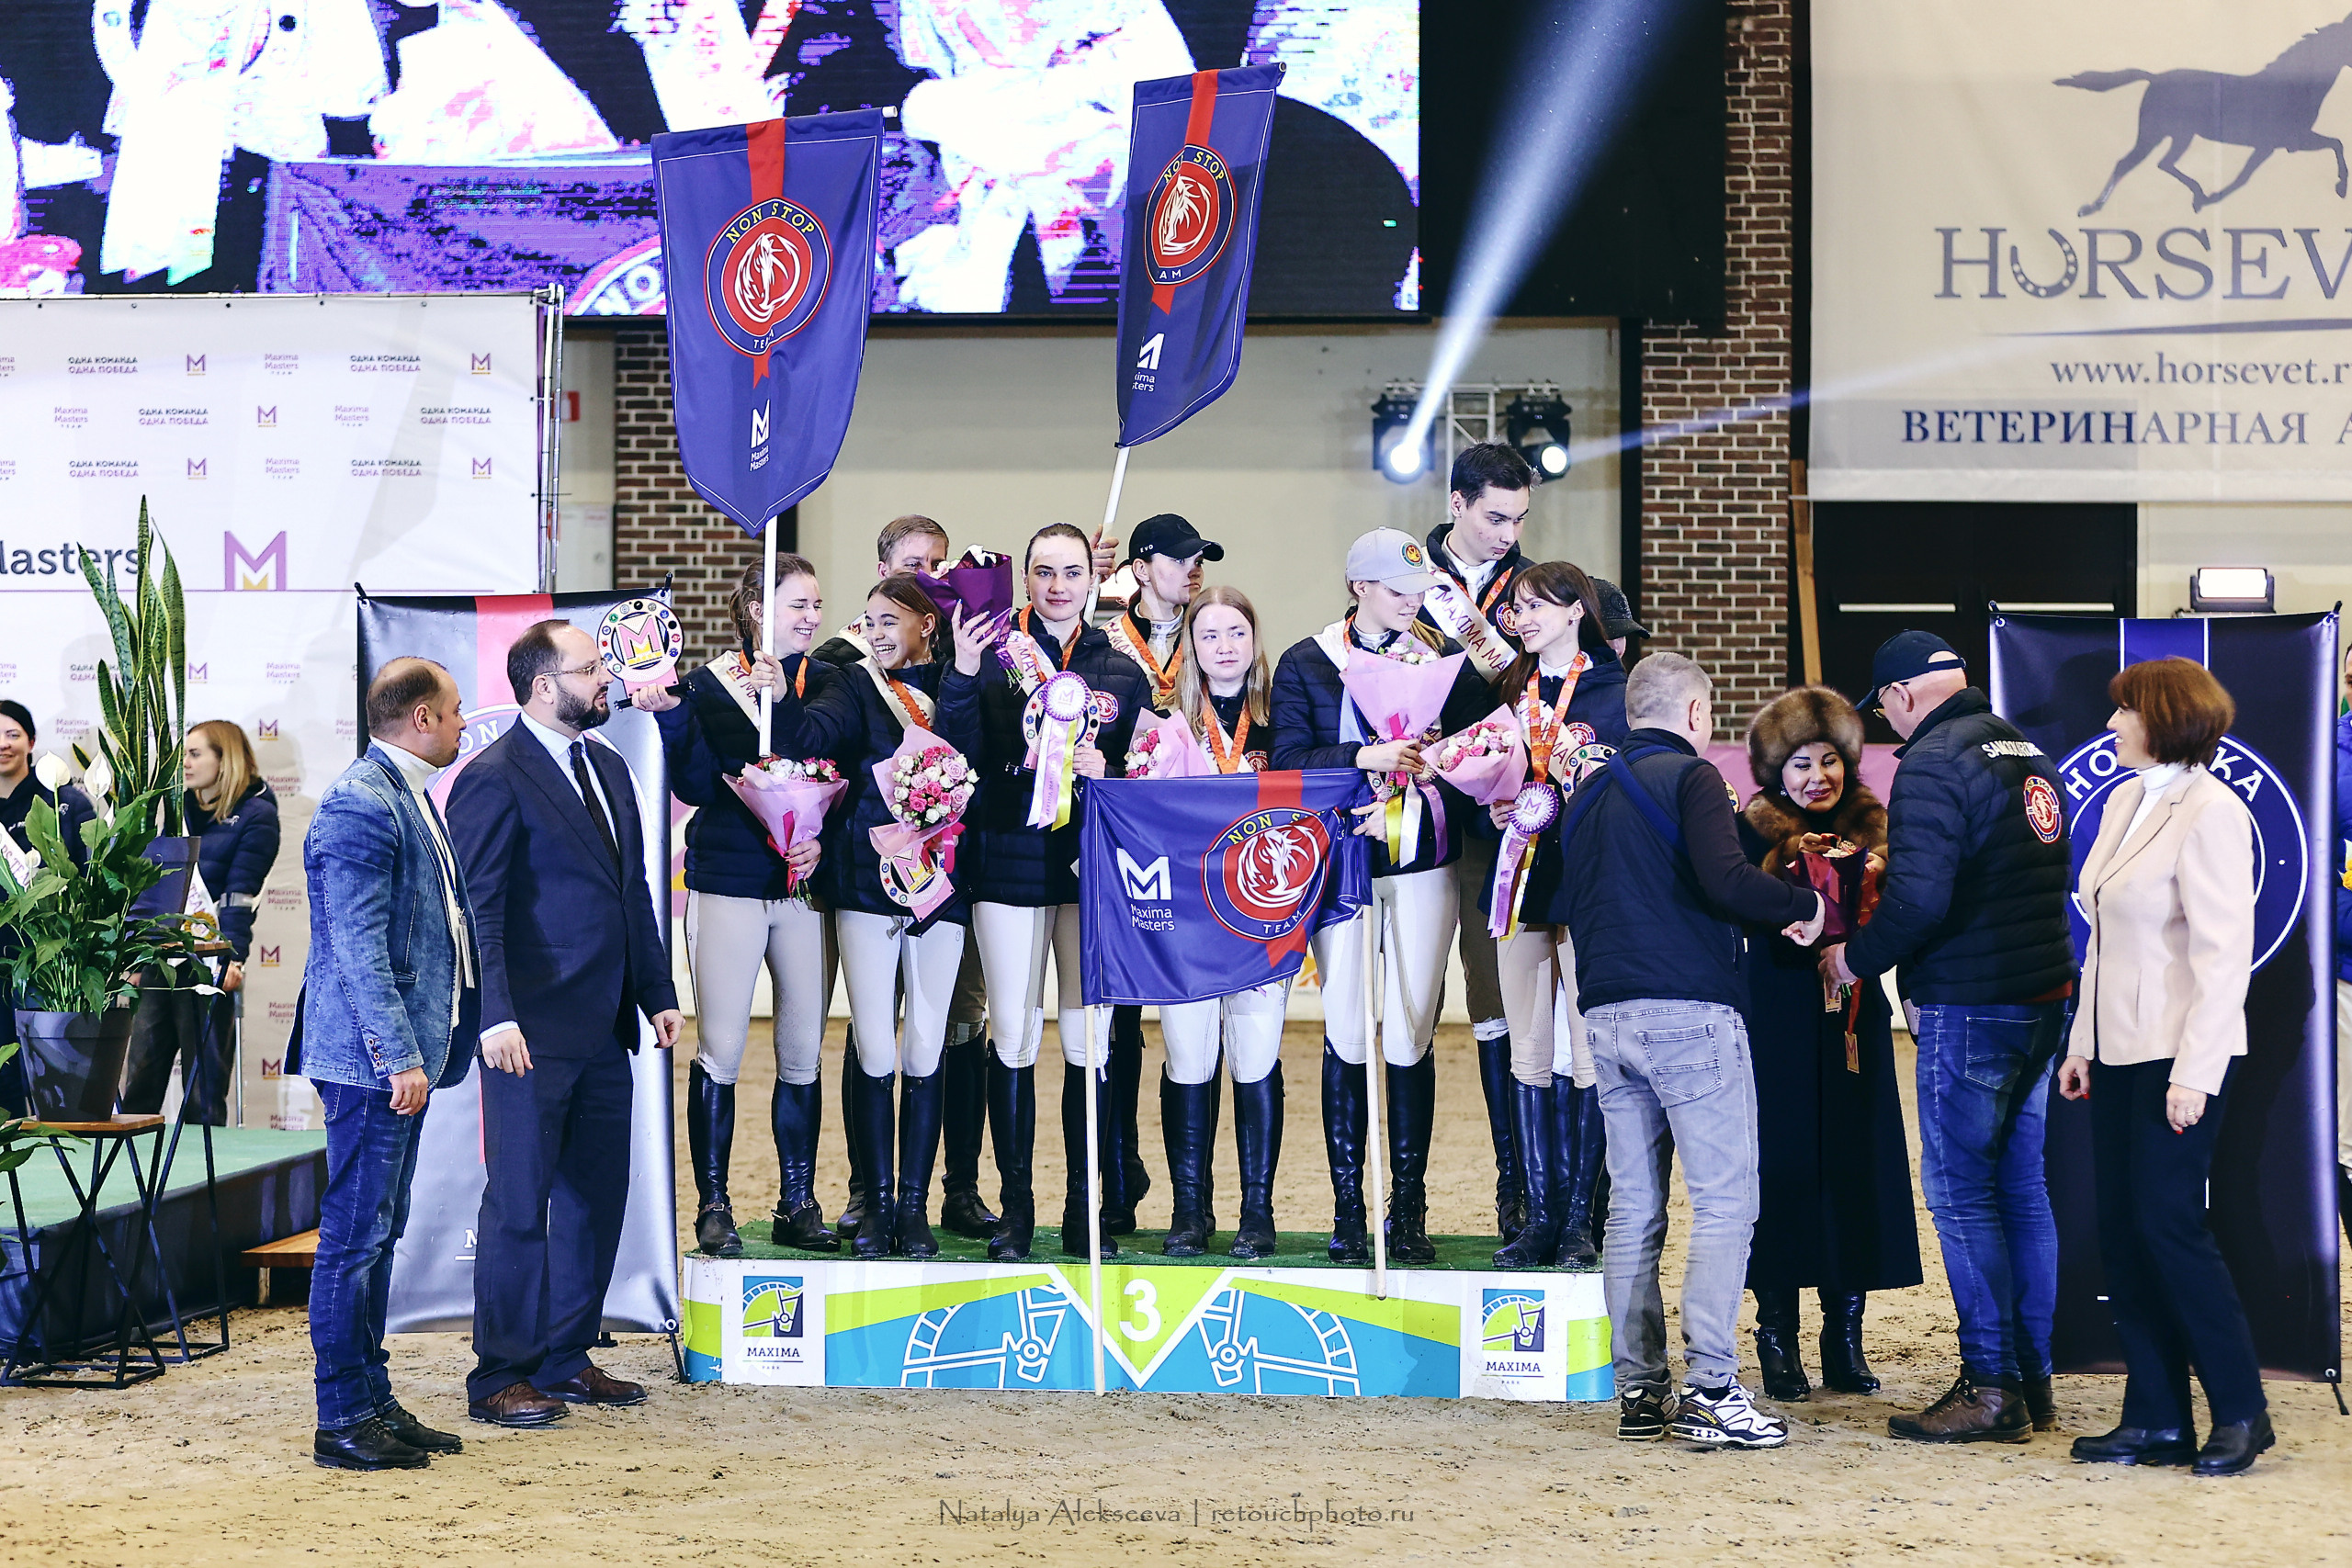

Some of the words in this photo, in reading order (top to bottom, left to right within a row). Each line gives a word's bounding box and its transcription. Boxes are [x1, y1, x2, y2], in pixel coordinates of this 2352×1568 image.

[1164, 154, 1184, 184] NO
[1193, 151, 1225, 181] STOP
[726, 208, 763, 243] NON
[772, 202, 815, 233] STOP
[1159, 269, 1182, 279] AM
[1901, 410, 2310, 445] ВЕТЕРИНАРНАЯ
[0, 539, 139, 575] asters
[1435, 590, 1487, 652] MAXIMA
[458, 719, 500, 754] ON
[1227, 814, 1272, 845] NON
[1130, 903, 1172, 919] Maxima
[1132, 915, 1175, 931] Masters
[1263, 910, 1303, 934] TEAM
[1119, 1278, 1161, 1342] 3
[747, 1347, 800, 1358] MAXIMA
[1486, 1361, 1542, 1372] MAXIMA
